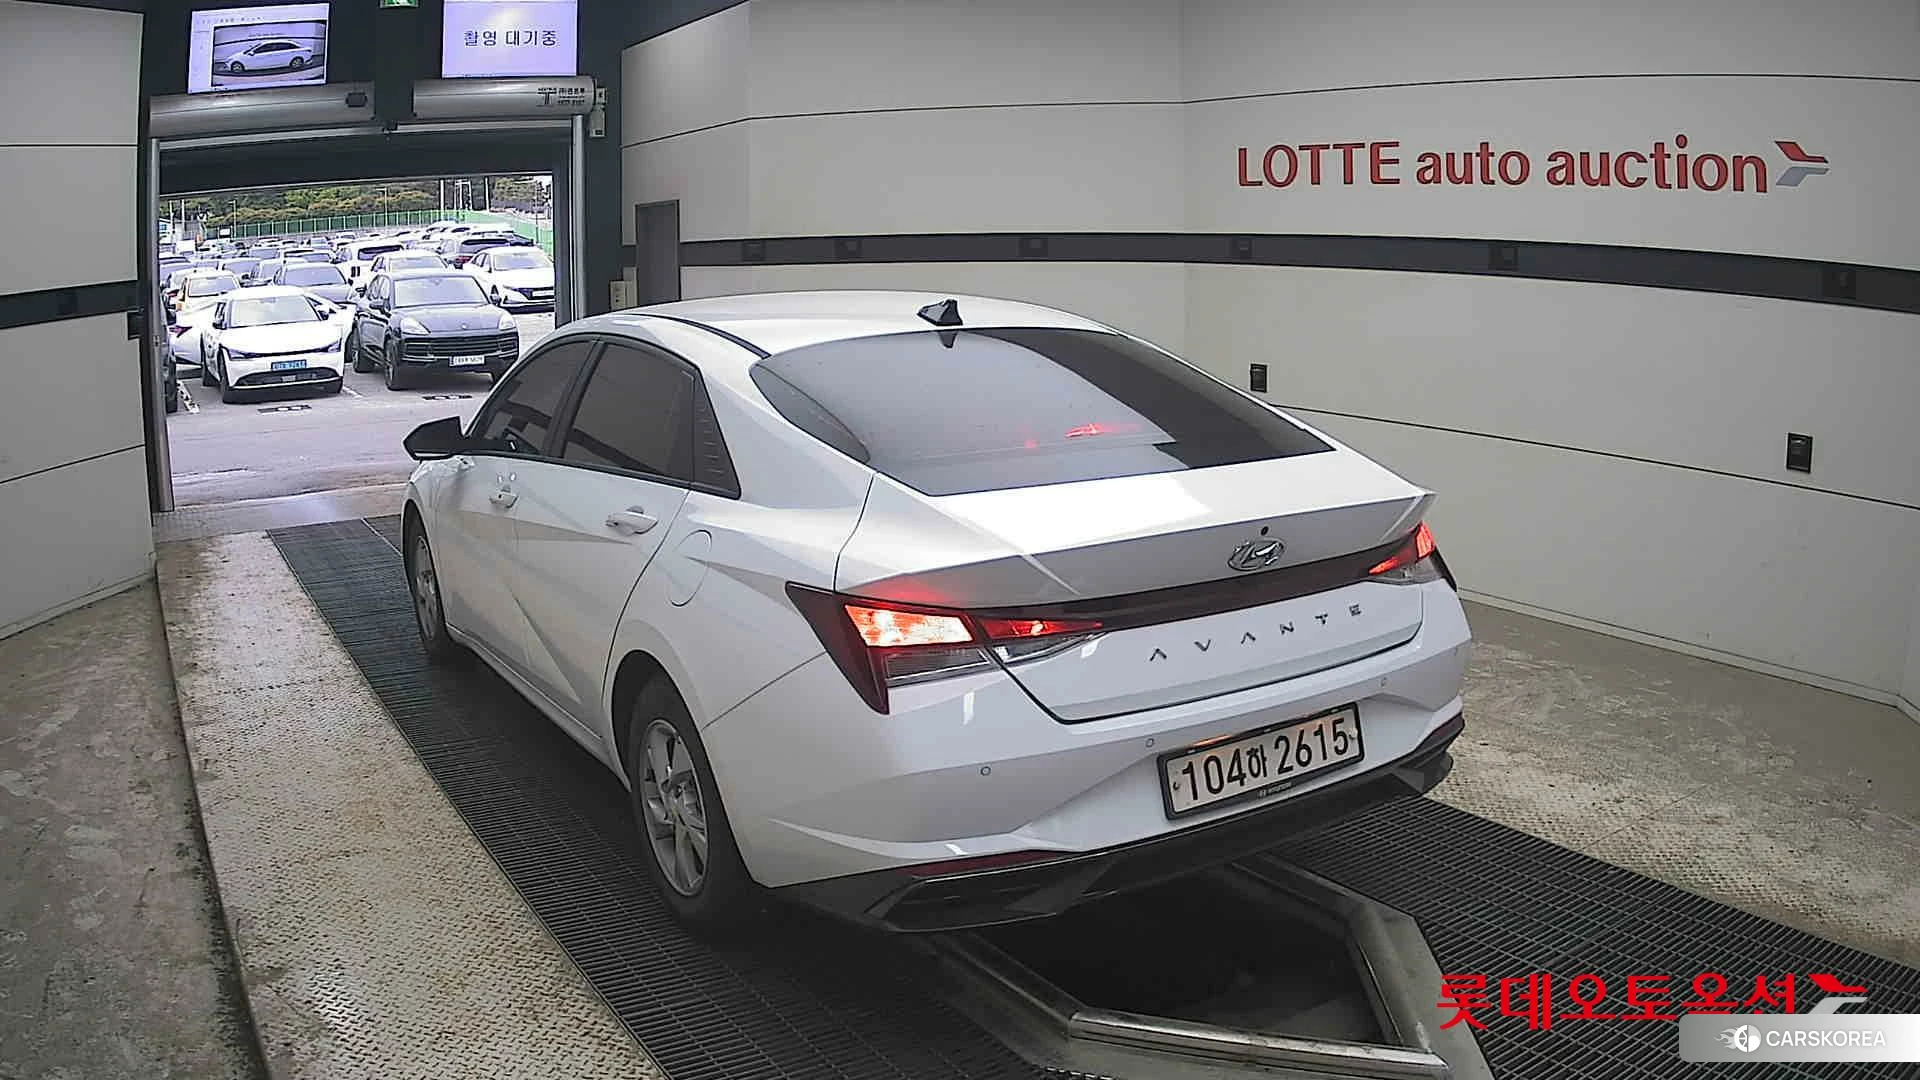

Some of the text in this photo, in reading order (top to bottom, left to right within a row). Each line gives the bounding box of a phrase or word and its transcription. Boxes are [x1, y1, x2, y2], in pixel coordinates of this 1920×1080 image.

[505, 30, 556, 47] 대기중
[1237, 133, 1768, 193] LOTTE auto auction
[1150, 604, 1361, 661] AVANTE
[1181, 717, 1350, 801] 104하 2615
